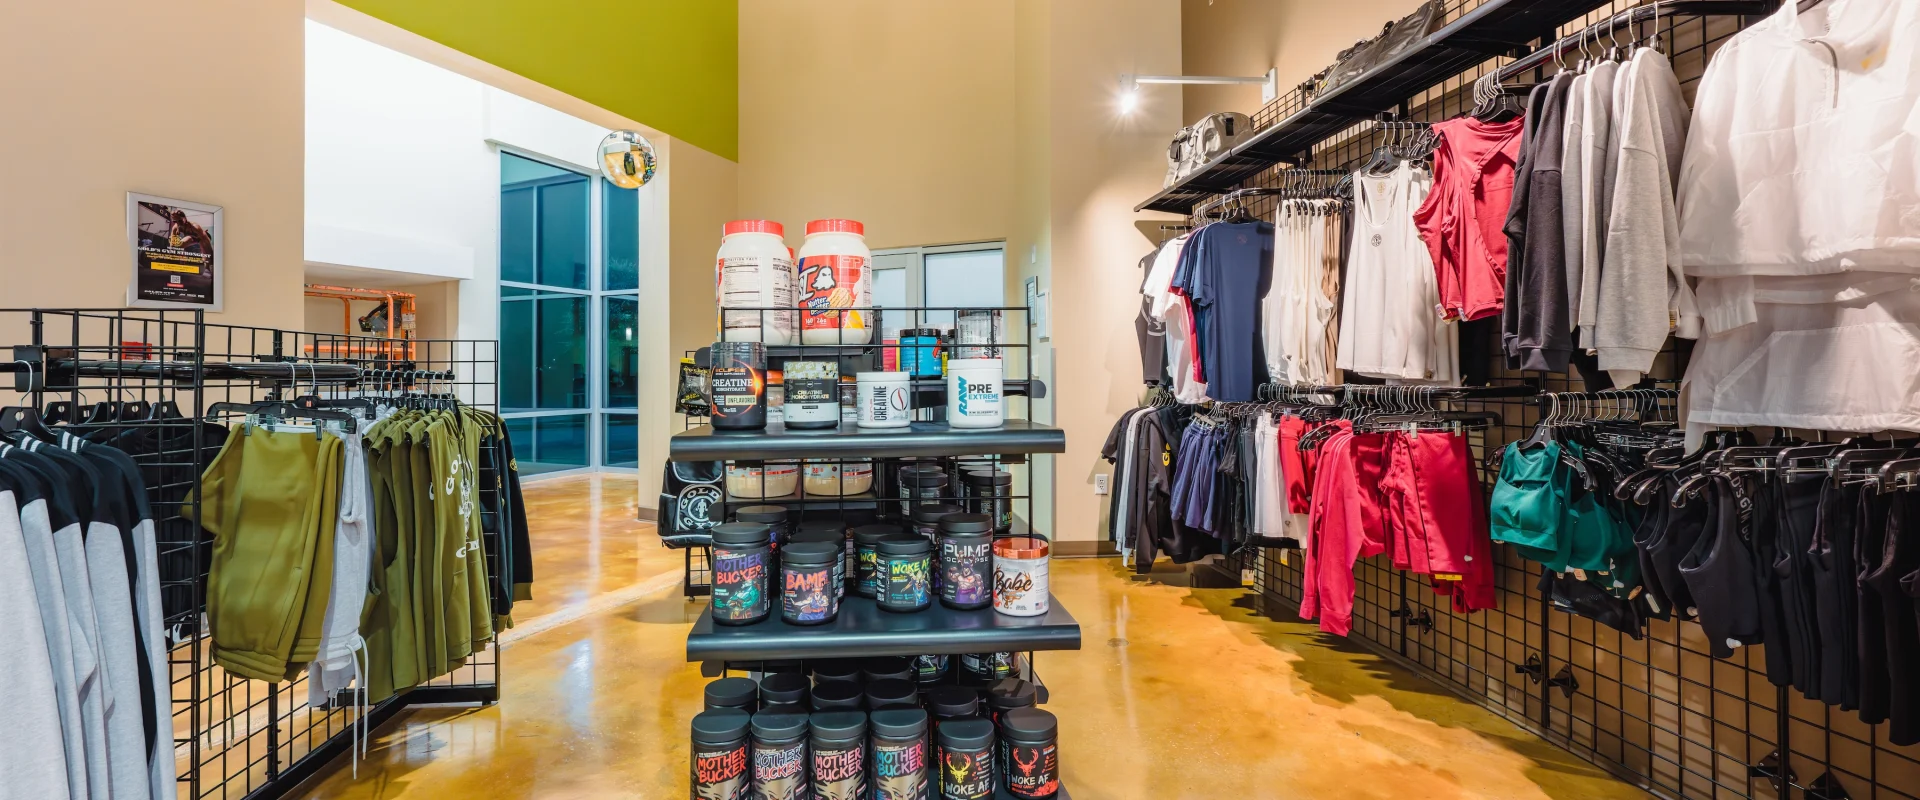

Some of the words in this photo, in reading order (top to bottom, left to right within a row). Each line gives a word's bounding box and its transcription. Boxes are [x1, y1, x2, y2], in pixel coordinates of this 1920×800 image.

[177, 250, 211, 259] STRONGEST
[711, 378, 753, 387] CREATINE
[968, 383, 993, 394] PRE
[873, 386, 887, 421] CREATINE
[957, 375, 968, 417] RAW
[681, 487, 720, 509] GOLD
[944, 543, 990, 557] PUMP
[715, 553, 763, 572] MOTHER
[892, 561, 920, 575] WOKE
[716, 565, 763, 585] BUCKER
[993, 569, 1034, 596] Babe
[697, 747, 746, 771] MOTHER
[755, 747, 802, 768] MOTHER
[815, 747, 862, 770] MOTHER
[876, 744, 923, 766] MOTHER
[699, 759, 746, 783] BUCKER
[755, 759, 803, 780] BUCKER
[816, 760, 863, 781] BUCKER
[877, 755, 924, 777] BUCKER
[945, 781, 976, 795] WOKE
[978, 778, 990, 793] AF
[1011, 774, 1036, 786] WOKE
[1038, 773, 1050, 785] AF
